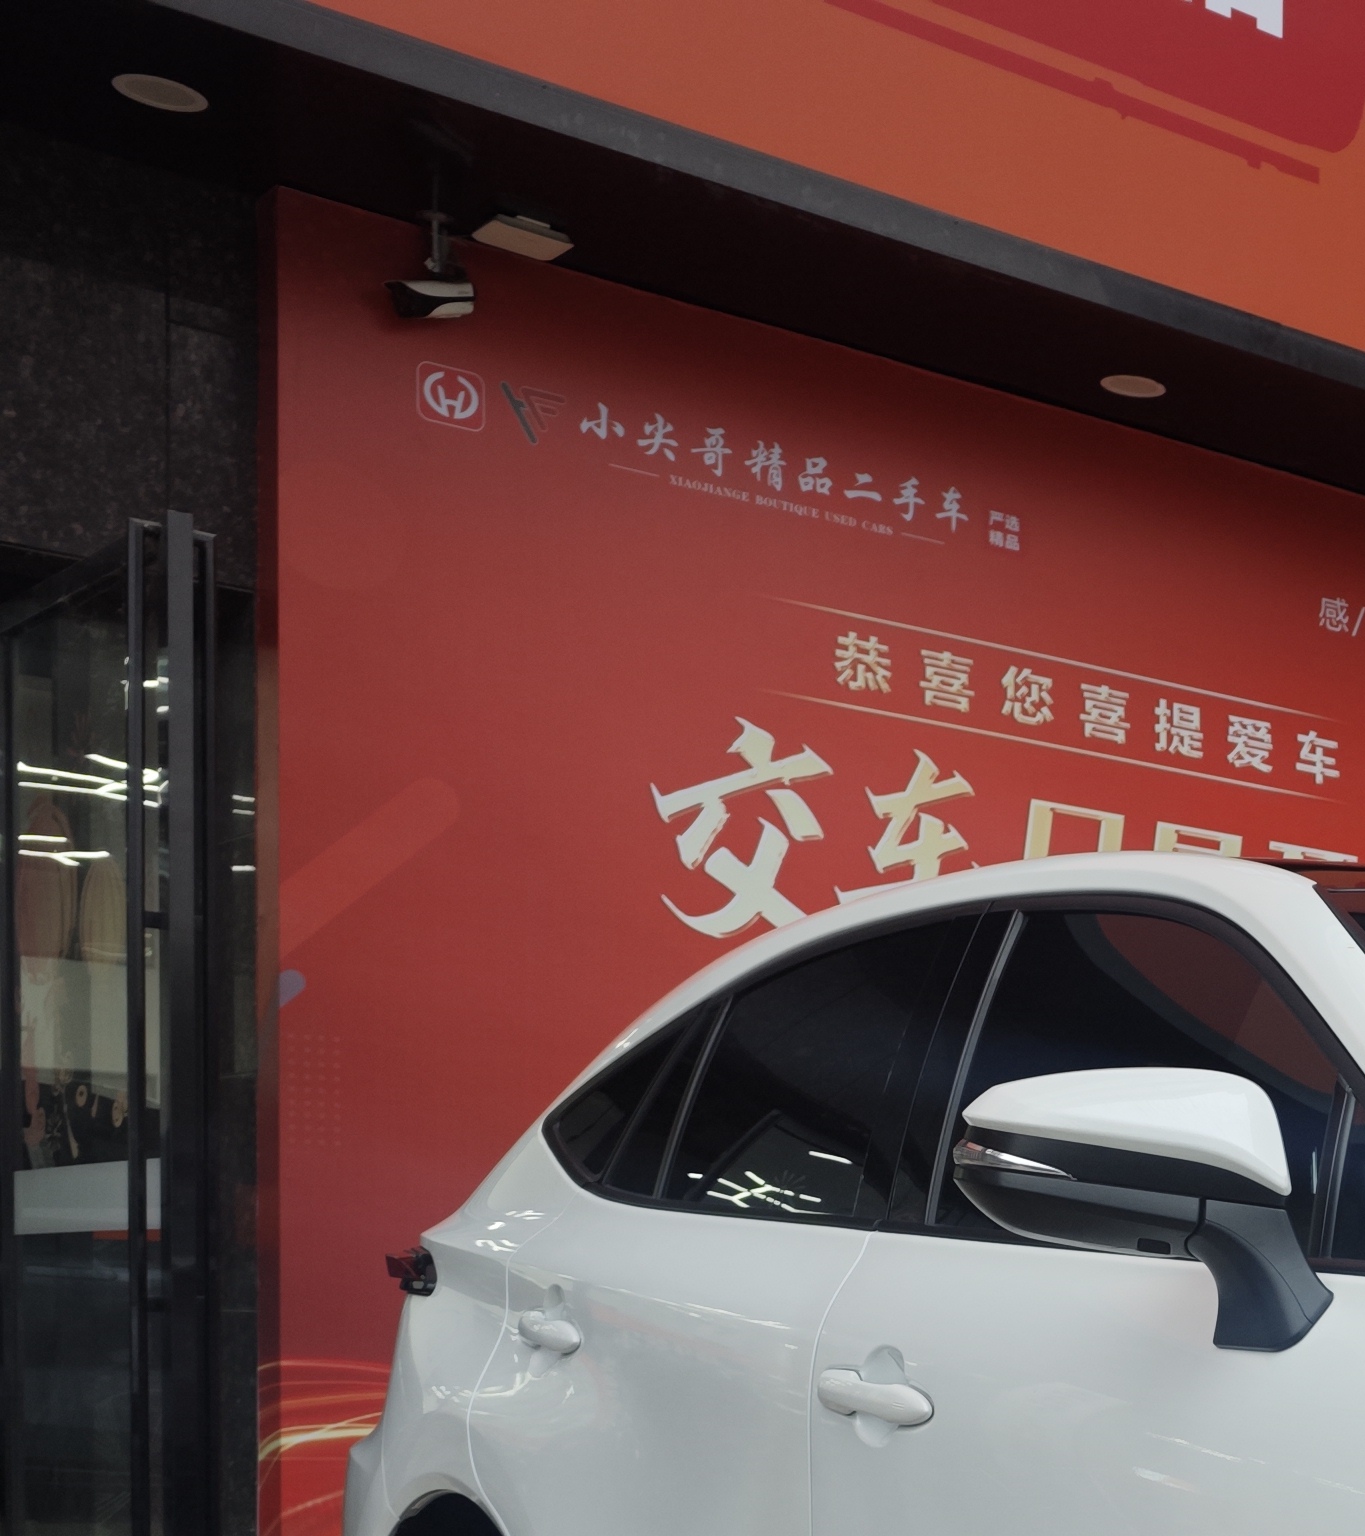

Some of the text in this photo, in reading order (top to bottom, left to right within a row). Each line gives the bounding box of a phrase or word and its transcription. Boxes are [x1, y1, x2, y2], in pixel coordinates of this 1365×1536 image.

[579, 402, 969, 533] 小尖哥精品二手车
[754, 493, 820, 519] BOUTIQUE
[823, 509, 857, 528] USED
[834, 630, 1343, 786] 恭喜您喜提爱车
